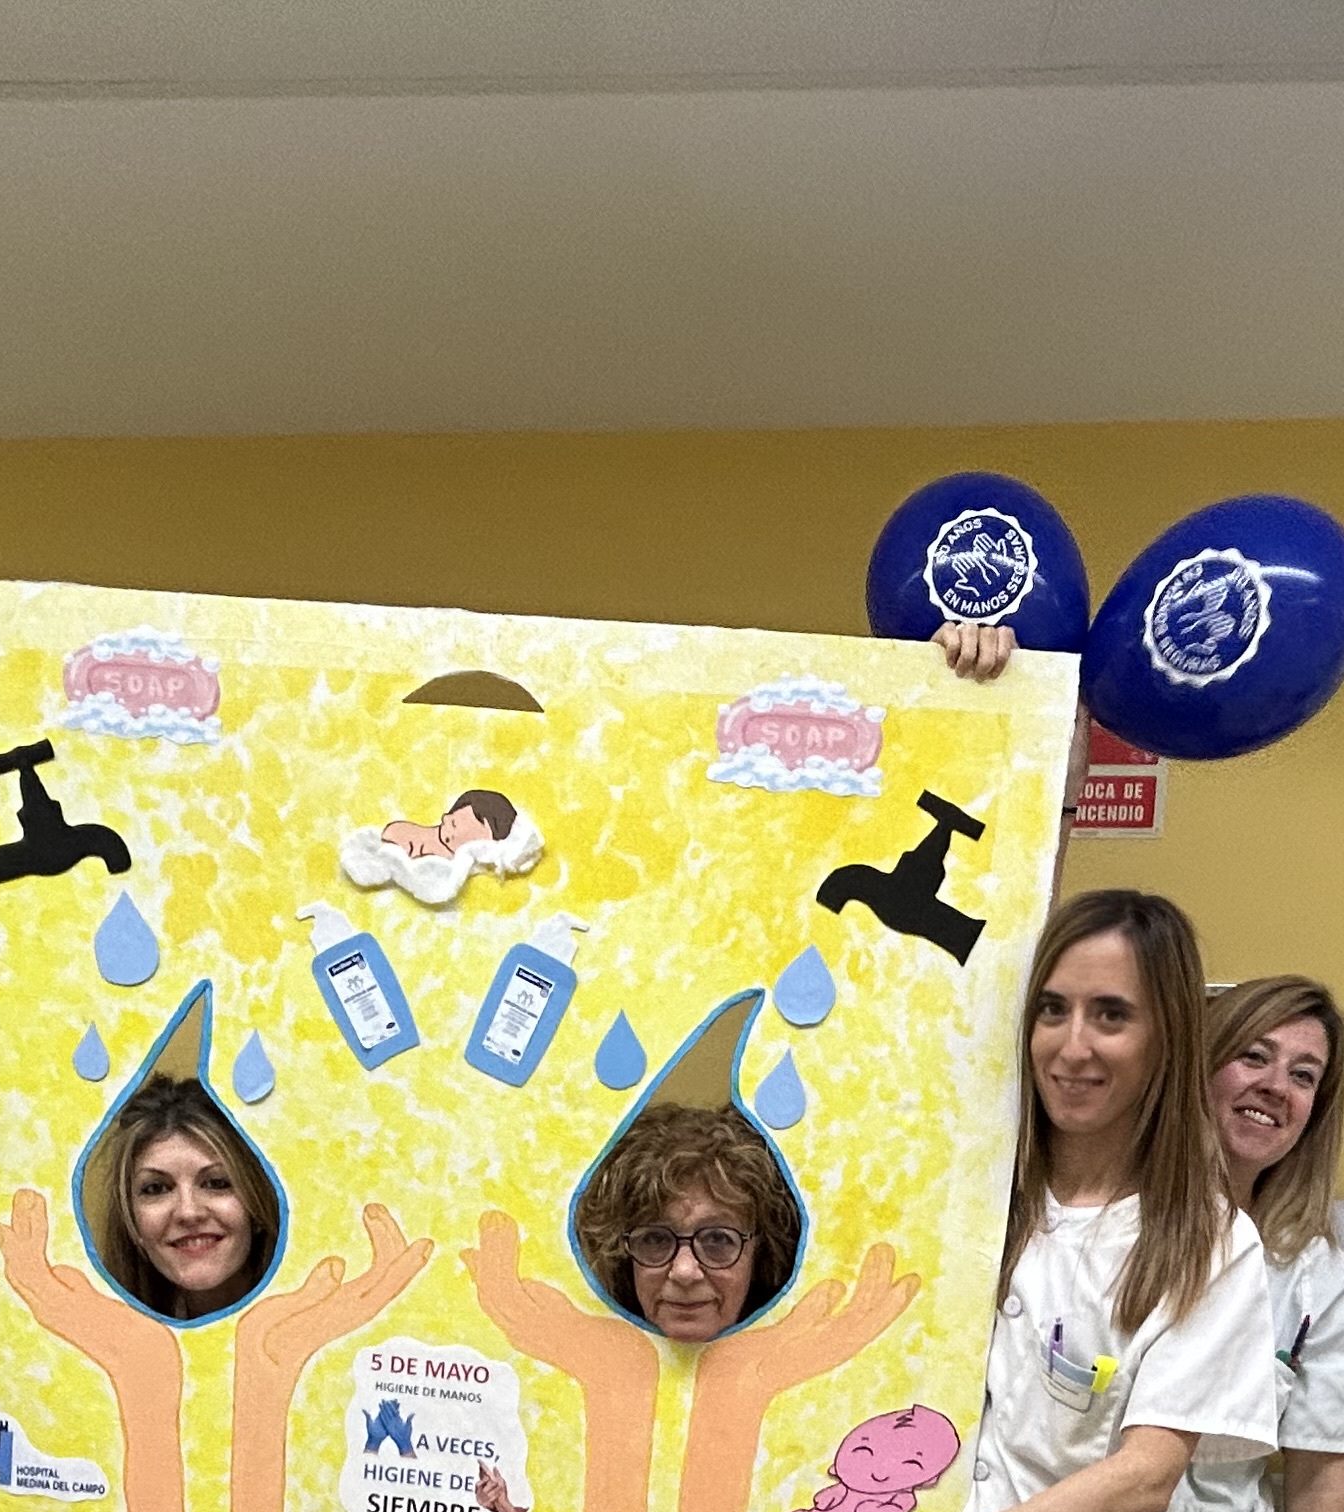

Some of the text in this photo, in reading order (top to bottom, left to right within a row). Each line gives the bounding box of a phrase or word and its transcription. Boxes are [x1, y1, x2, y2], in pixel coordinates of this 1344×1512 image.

[948, 518, 983, 545] AÑOS
[943, 588, 959, 609] EN
[960, 591, 1009, 614] MANOS
[104, 671, 185, 699] SOAP
[761, 721, 846, 749] SOAP
[1079, 783, 1144, 799] OCA DE
[1076, 805, 1144, 822] NCENDIO
[371, 1353, 490, 1384] 5 DE MAYO
[375, 1381, 483, 1404] HIGIENE DE MANOS
[416, 1433, 501, 1463] A VECES,
[16, 1465, 60, 1479] HOSPITAL
[363, 1464, 474, 1492] HIGIENE DE
[16, 1479, 106, 1495] MEDINA DEL CAMPO
